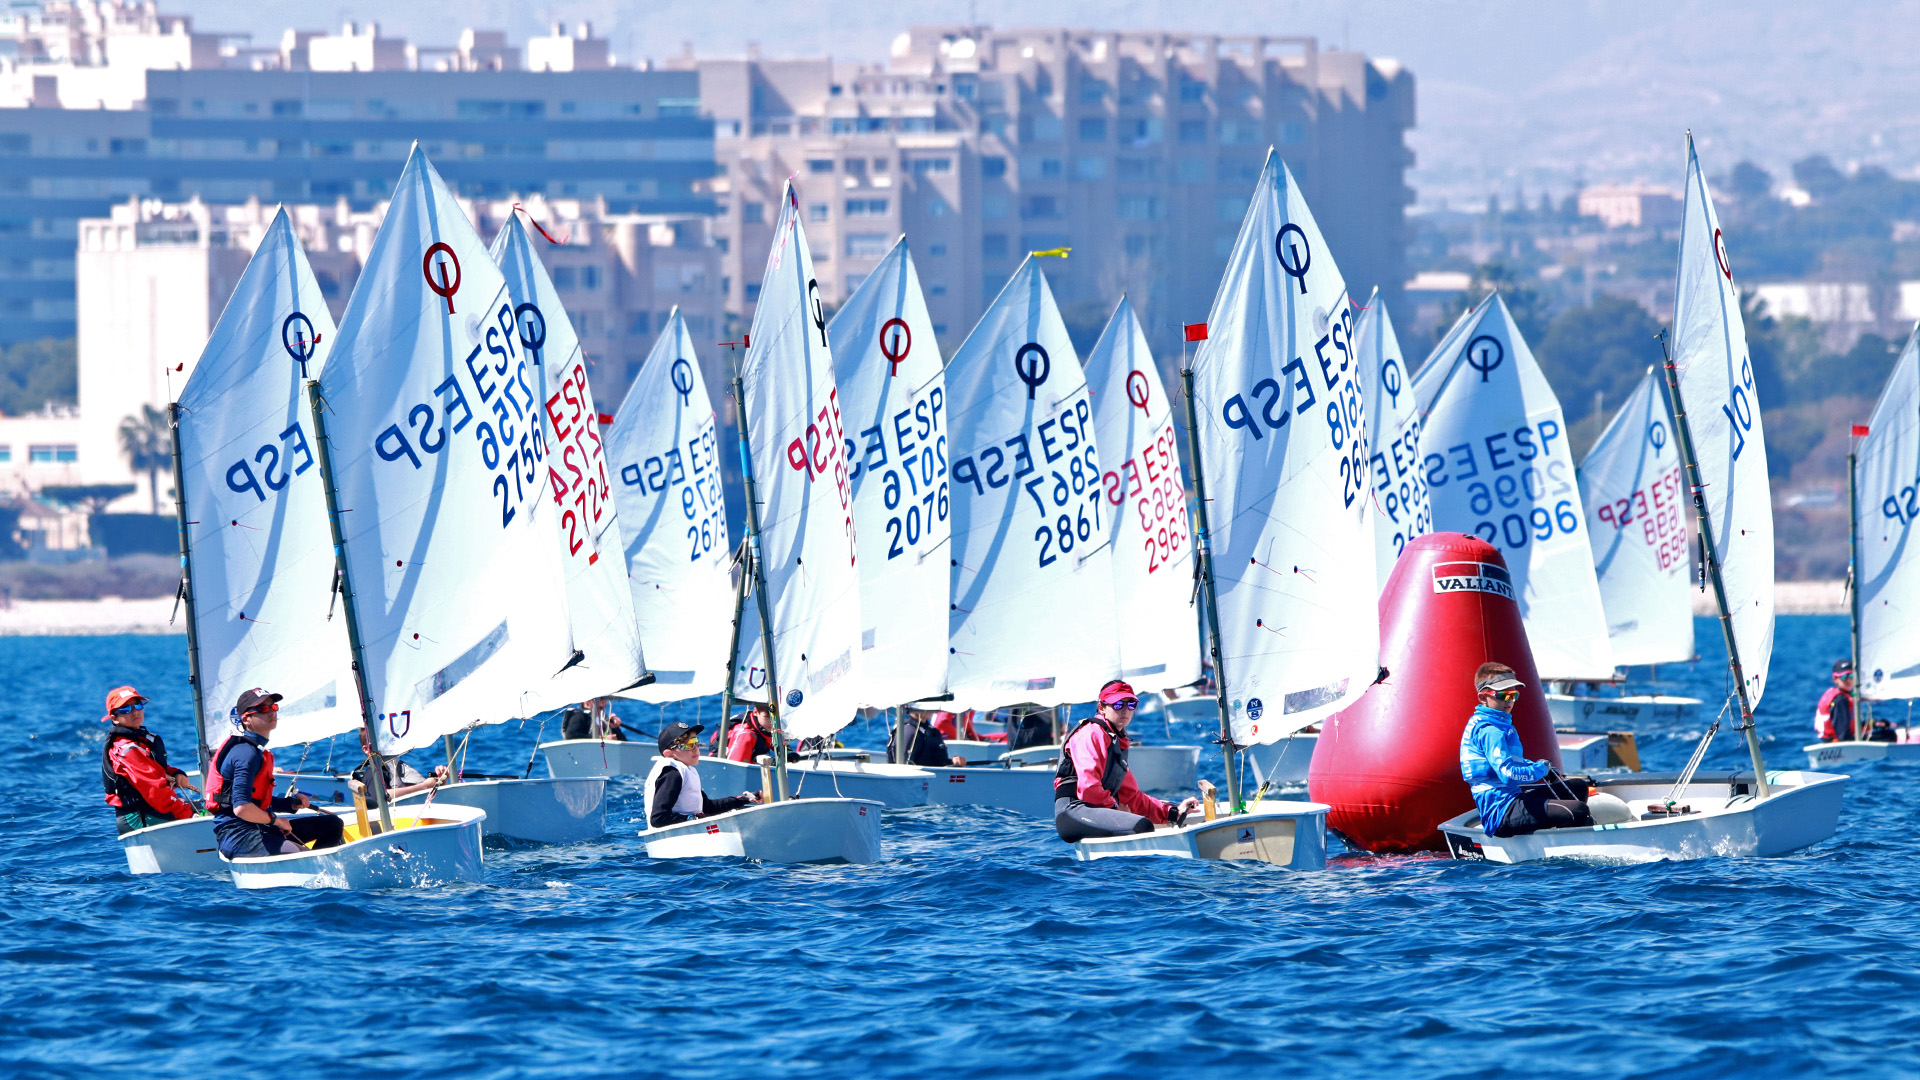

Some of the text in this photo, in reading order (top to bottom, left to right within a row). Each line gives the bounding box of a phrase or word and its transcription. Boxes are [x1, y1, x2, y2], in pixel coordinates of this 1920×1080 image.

[465, 303, 515, 403] ESP
[1314, 308, 1353, 391] ESP
[545, 364, 586, 443] ESP
[894, 387, 943, 456] ESP
[1038, 399, 1088, 464] ESP
[493, 412, 542, 529] 2756
[689, 426, 716, 475] ESP
[1143, 426, 1174, 484] ESP
[1340, 419, 1369, 510] 2618
[1391, 422, 1419, 478] ESP
[1484, 420, 1559, 471] ESP
[562, 460, 609, 557] 2724
[886, 481, 948, 561] 2076
[1652, 468, 1681, 508] ESP
[687, 505, 726, 562] 2679
[1035, 489, 1100, 568] 2867
[1145, 507, 1187, 574] 2963
[1475, 500, 1578, 551] 2096
[1655, 528, 1688, 572] 1698
[1437, 577, 1514, 598] VALIANT
